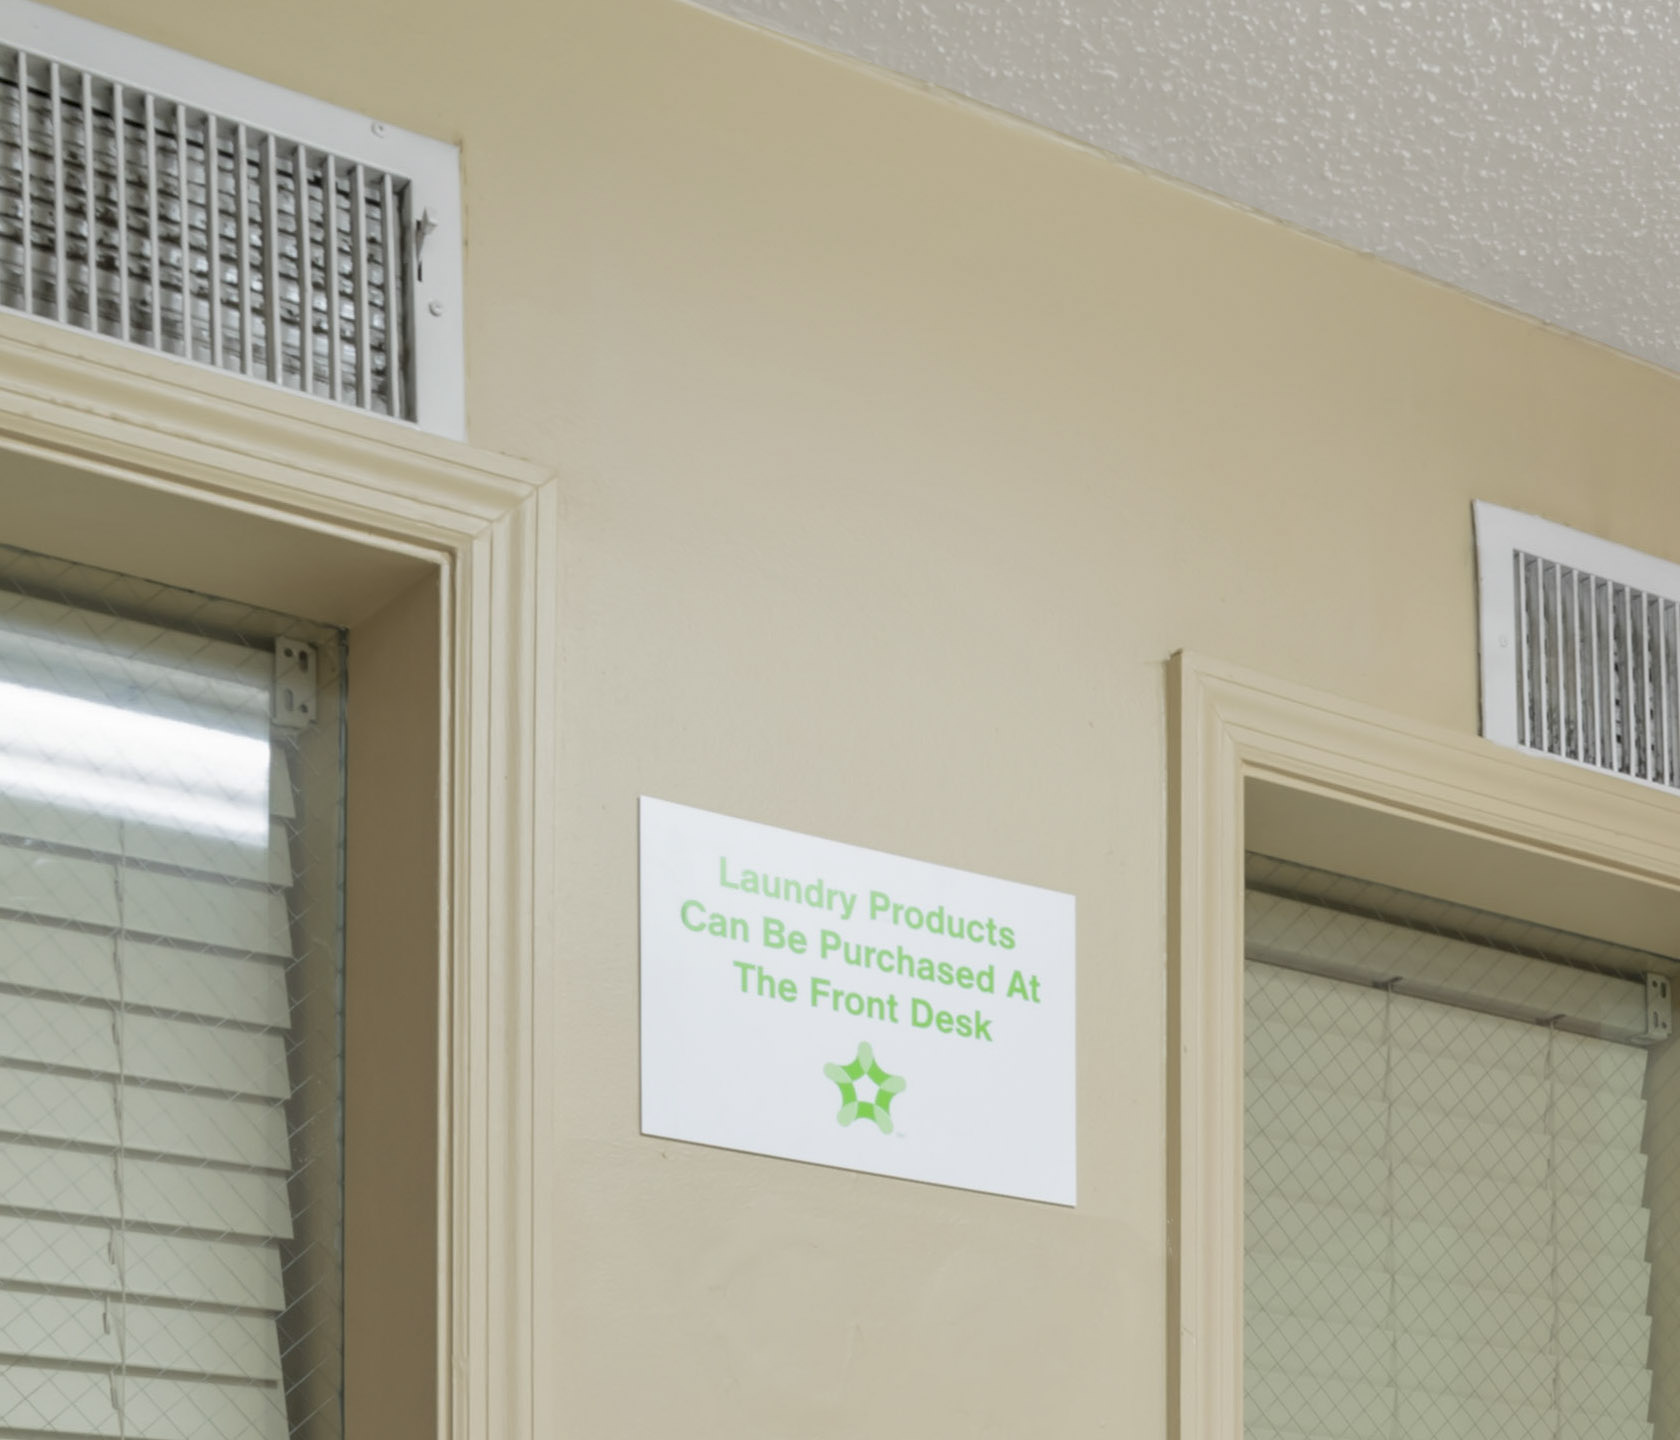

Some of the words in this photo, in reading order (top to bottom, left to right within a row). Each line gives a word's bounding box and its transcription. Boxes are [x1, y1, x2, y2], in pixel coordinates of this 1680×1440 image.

[719, 856, 857, 920] Laundry
[869, 890, 1016, 950] Products
[680, 899, 750, 943] Can
[762, 917, 807, 954] Be
[819, 929, 995, 994] Purchased
[1006, 970, 1041, 1003] At
[733, 960, 798, 1002] The
[810, 977, 899, 1024] Front
[910, 998, 993, 1042] Desk
